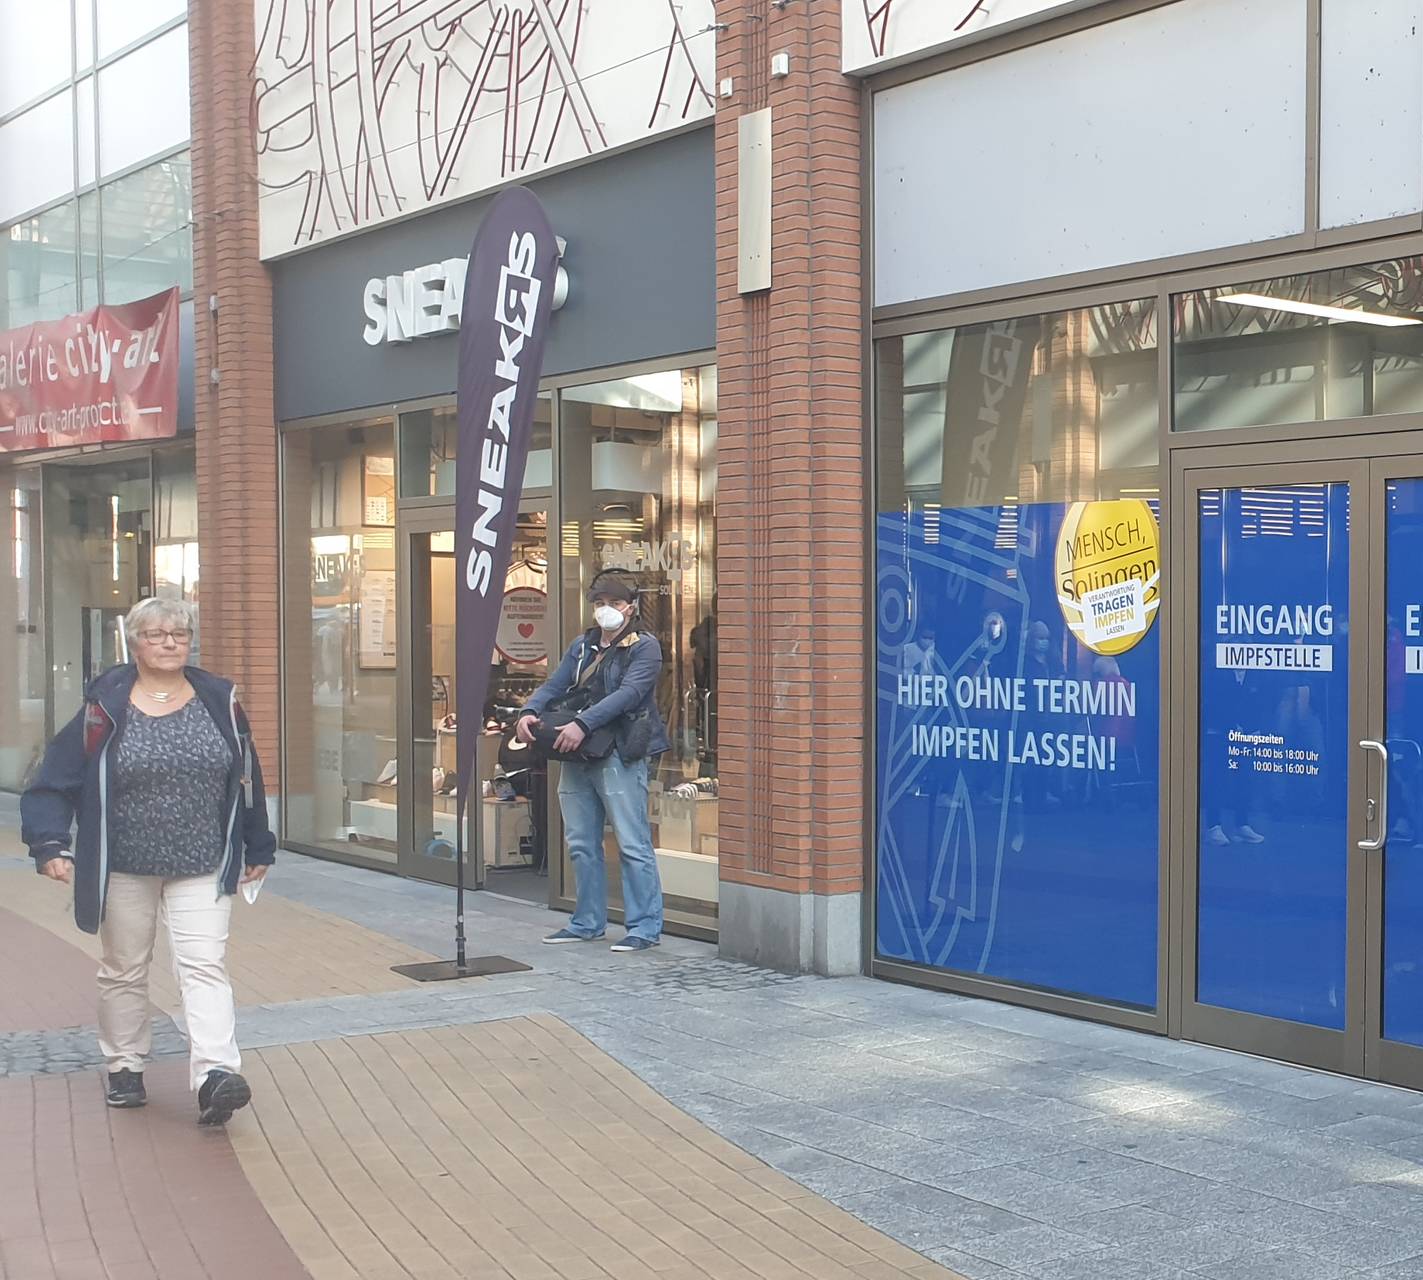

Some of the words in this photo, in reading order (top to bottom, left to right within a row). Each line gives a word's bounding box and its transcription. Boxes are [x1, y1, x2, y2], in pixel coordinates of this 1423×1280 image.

[1066, 518, 1146, 562] MENSCH,
[1062, 559, 1158, 605] Solingen
[1088, 584, 1135, 603] VERANTWORTUNG
[1091, 594, 1134, 616] TRAGEN
[1095, 608, 1134, 629] IMPFEN
[1216, 604, 1333, 636] EINGANG
[1106, 625, 1125, 636] LASSEN
[1225, 646, 1321, 668] IMPFSTELLE
[898, 674, 949, 708] HIER
[956, 675, 1026, 711] OHNE
[1033, 679, 1136, 717] TERMIN
[912, 724, 998, 762] IMPFEN
[1008, 730, 1116, 771] LASSEN!
[1228, 730, 1284, 745] Öffnungszeiten
[1253, 747, 1272, 758] 14:00
[1273, 749, 1283, 759] bis
[1285, 750, 1304, 760] 18:00
[1306, 750, 1319, 761] Uhr
[1253, 761, 1272, 771] 10:00
[1273, 762, 1283, 772] bis
[1285, 763, 1304, 774] 16:00
[1306, 764, 1319, 775] Uhr
